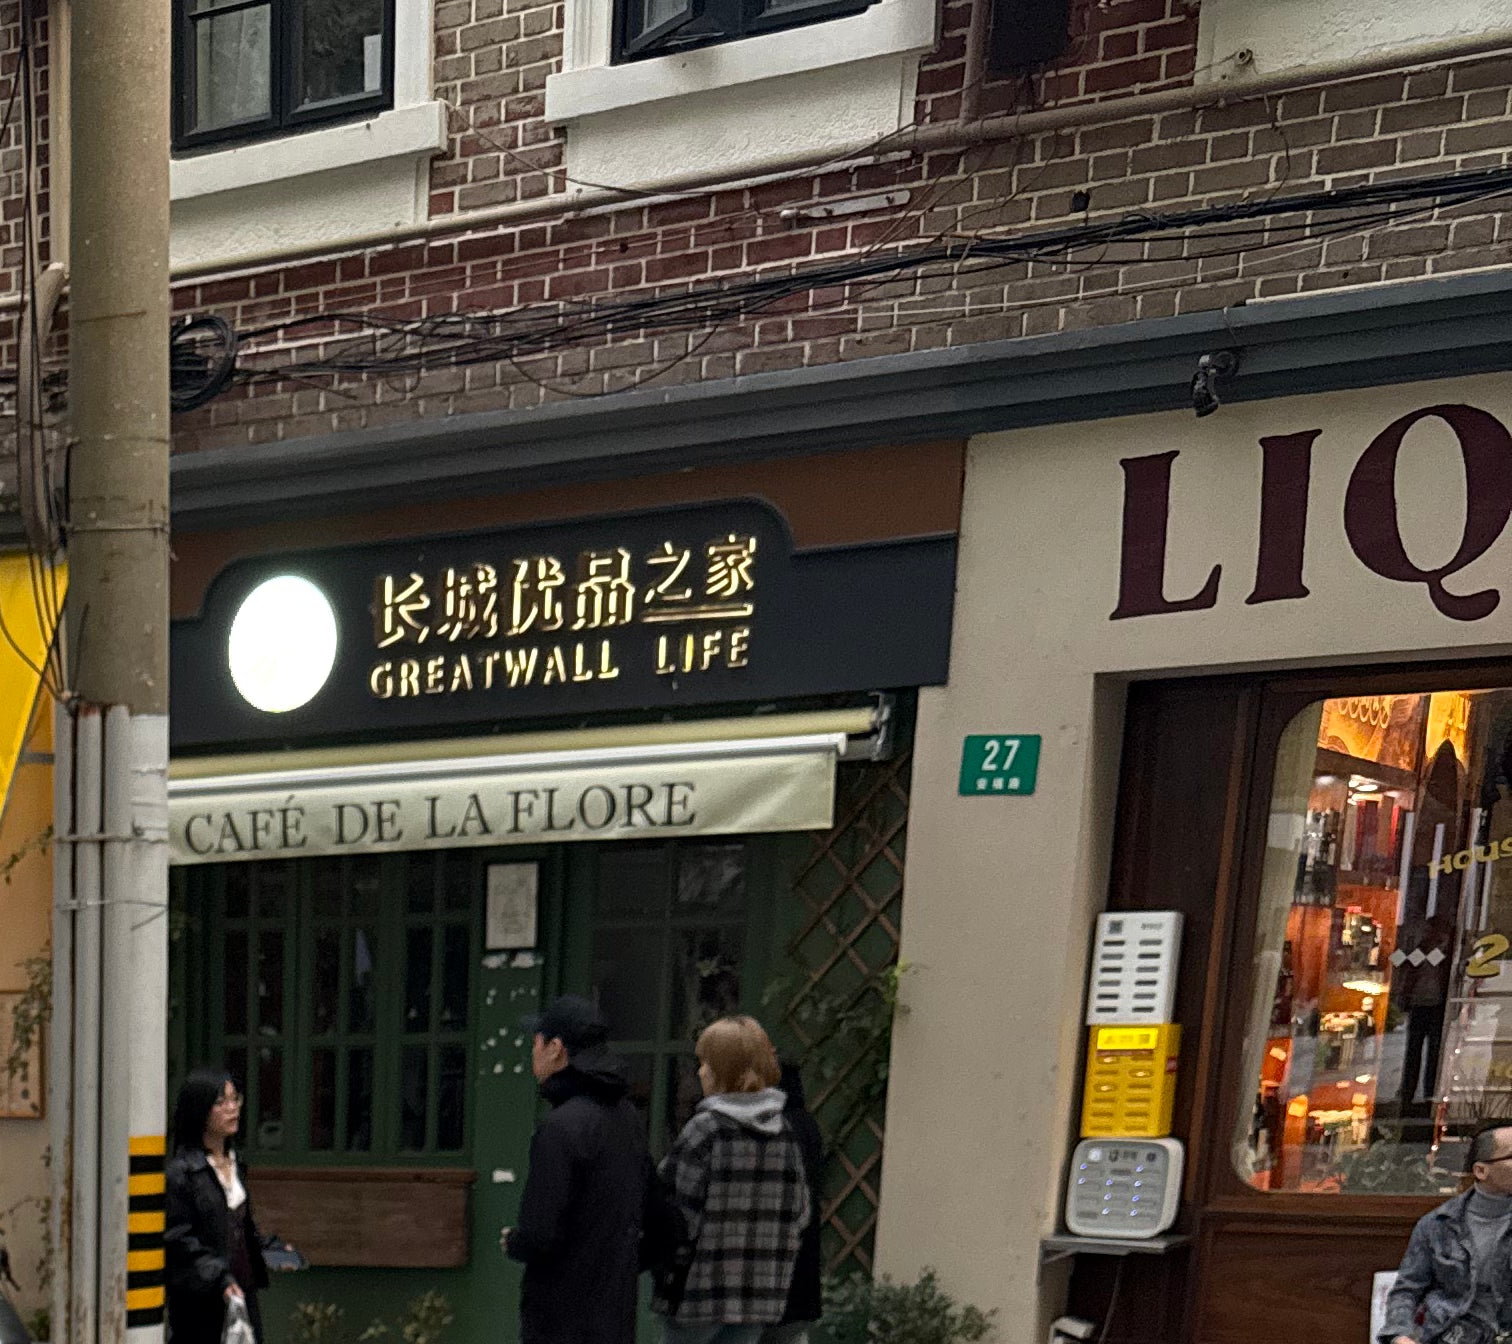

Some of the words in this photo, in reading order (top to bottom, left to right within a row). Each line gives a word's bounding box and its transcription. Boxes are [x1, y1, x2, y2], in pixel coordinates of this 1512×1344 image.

[1108, 403, 1512, 621] LIQ
[377, 533, 757, 648] 长城优品之家
[370, 639, 620, 699] GREATWALL
[655, 627, 751, 675] LIFE
[981, 739, 1020, 771] 27
[184, 795, 308, 856] CAFÉ
[332, 799, 403, 845] DE
[423, 793, 491, 840] LA
[506, 782, 698, 834] FLORE
